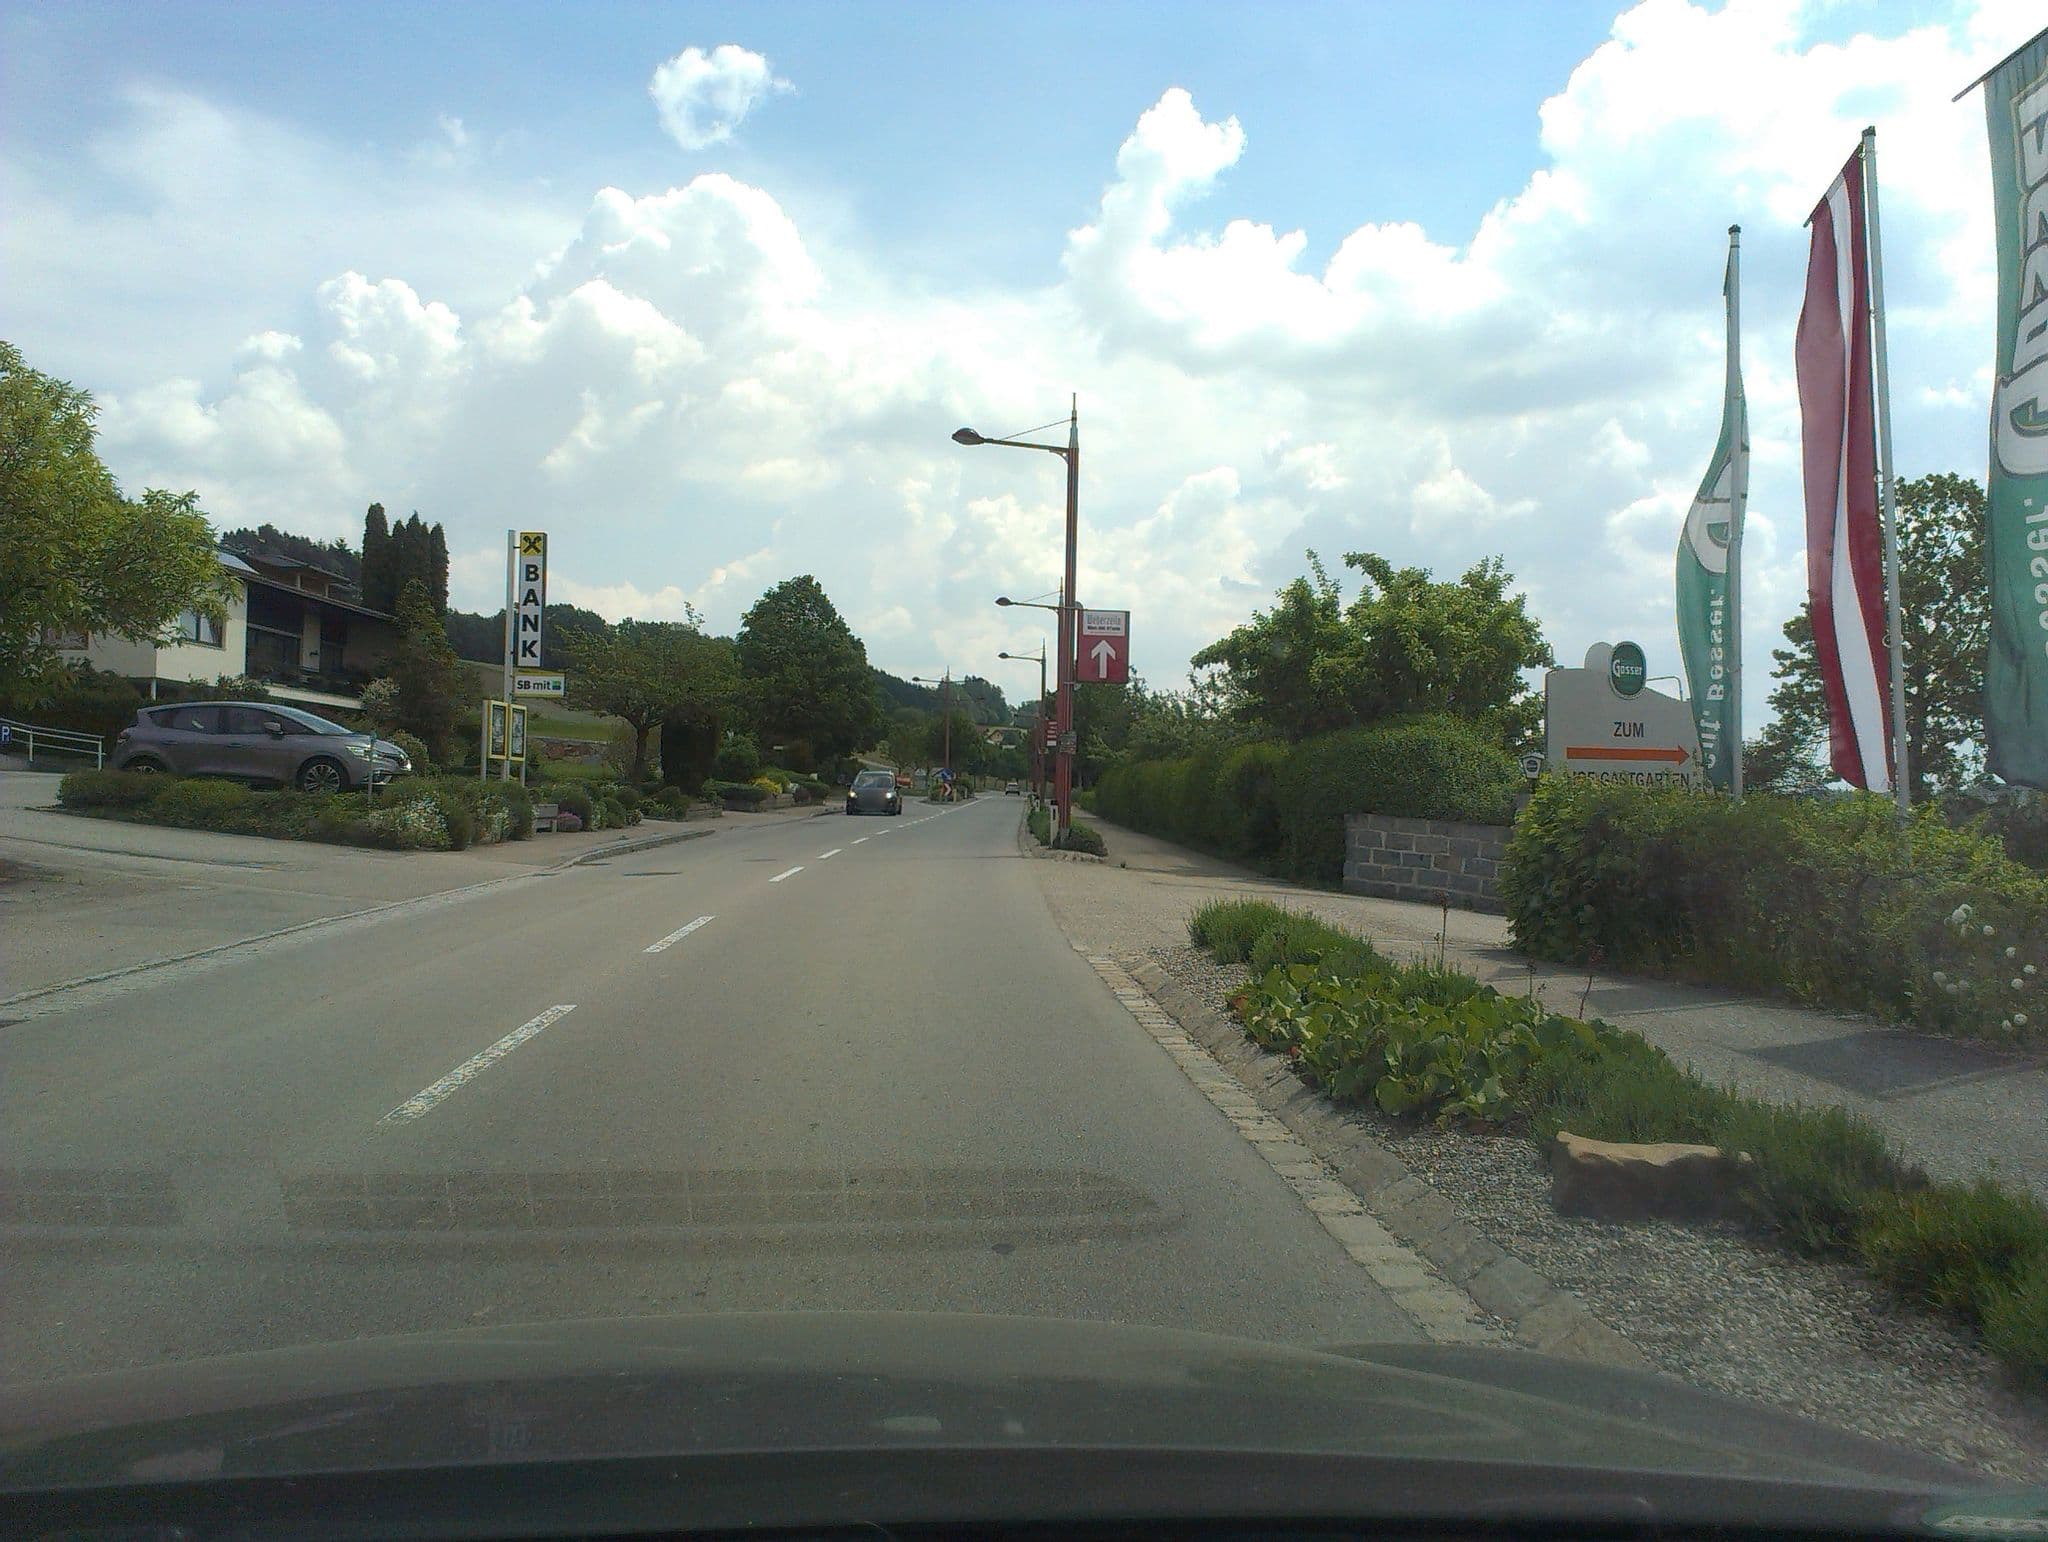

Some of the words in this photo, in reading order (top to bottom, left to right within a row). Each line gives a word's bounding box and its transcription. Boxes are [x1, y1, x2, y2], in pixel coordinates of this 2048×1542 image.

[521, 564, 540, 658] BANK
[516, 680, 532, 691] SB
[533, 680, 551, 691] mit
[1613, 721, 1644, 738] ZUM
